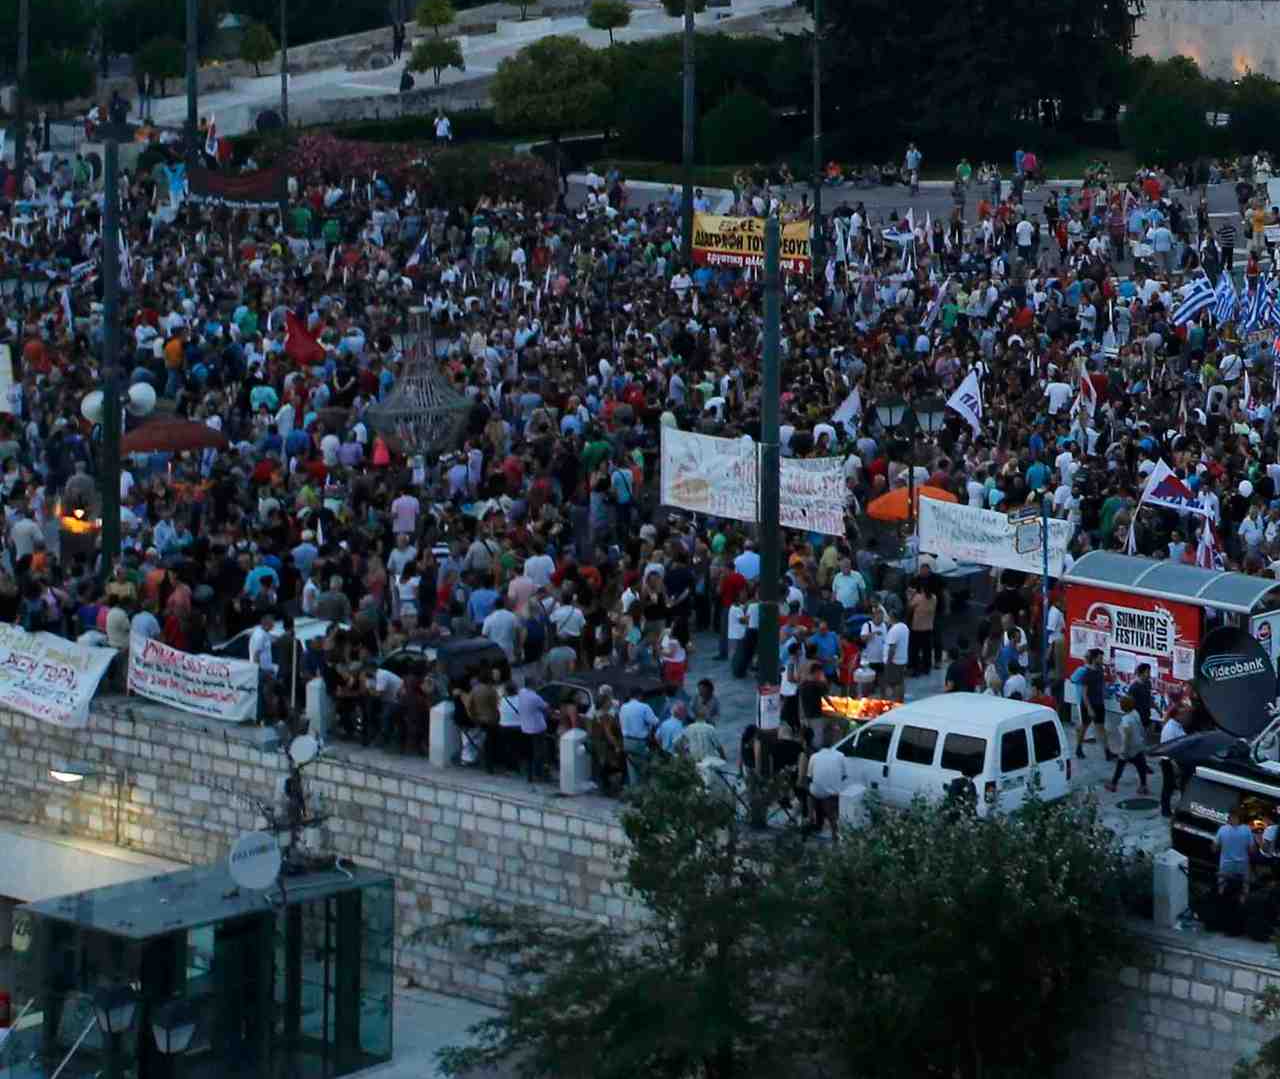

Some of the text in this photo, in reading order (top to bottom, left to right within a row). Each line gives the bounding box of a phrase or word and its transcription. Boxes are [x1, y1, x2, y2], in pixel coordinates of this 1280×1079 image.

[1116, 611, 1155, 632] SUMMER
[1115, 627, 1155, 650] FESTIVAL
[1156, 618, 1168, 652] 2015
